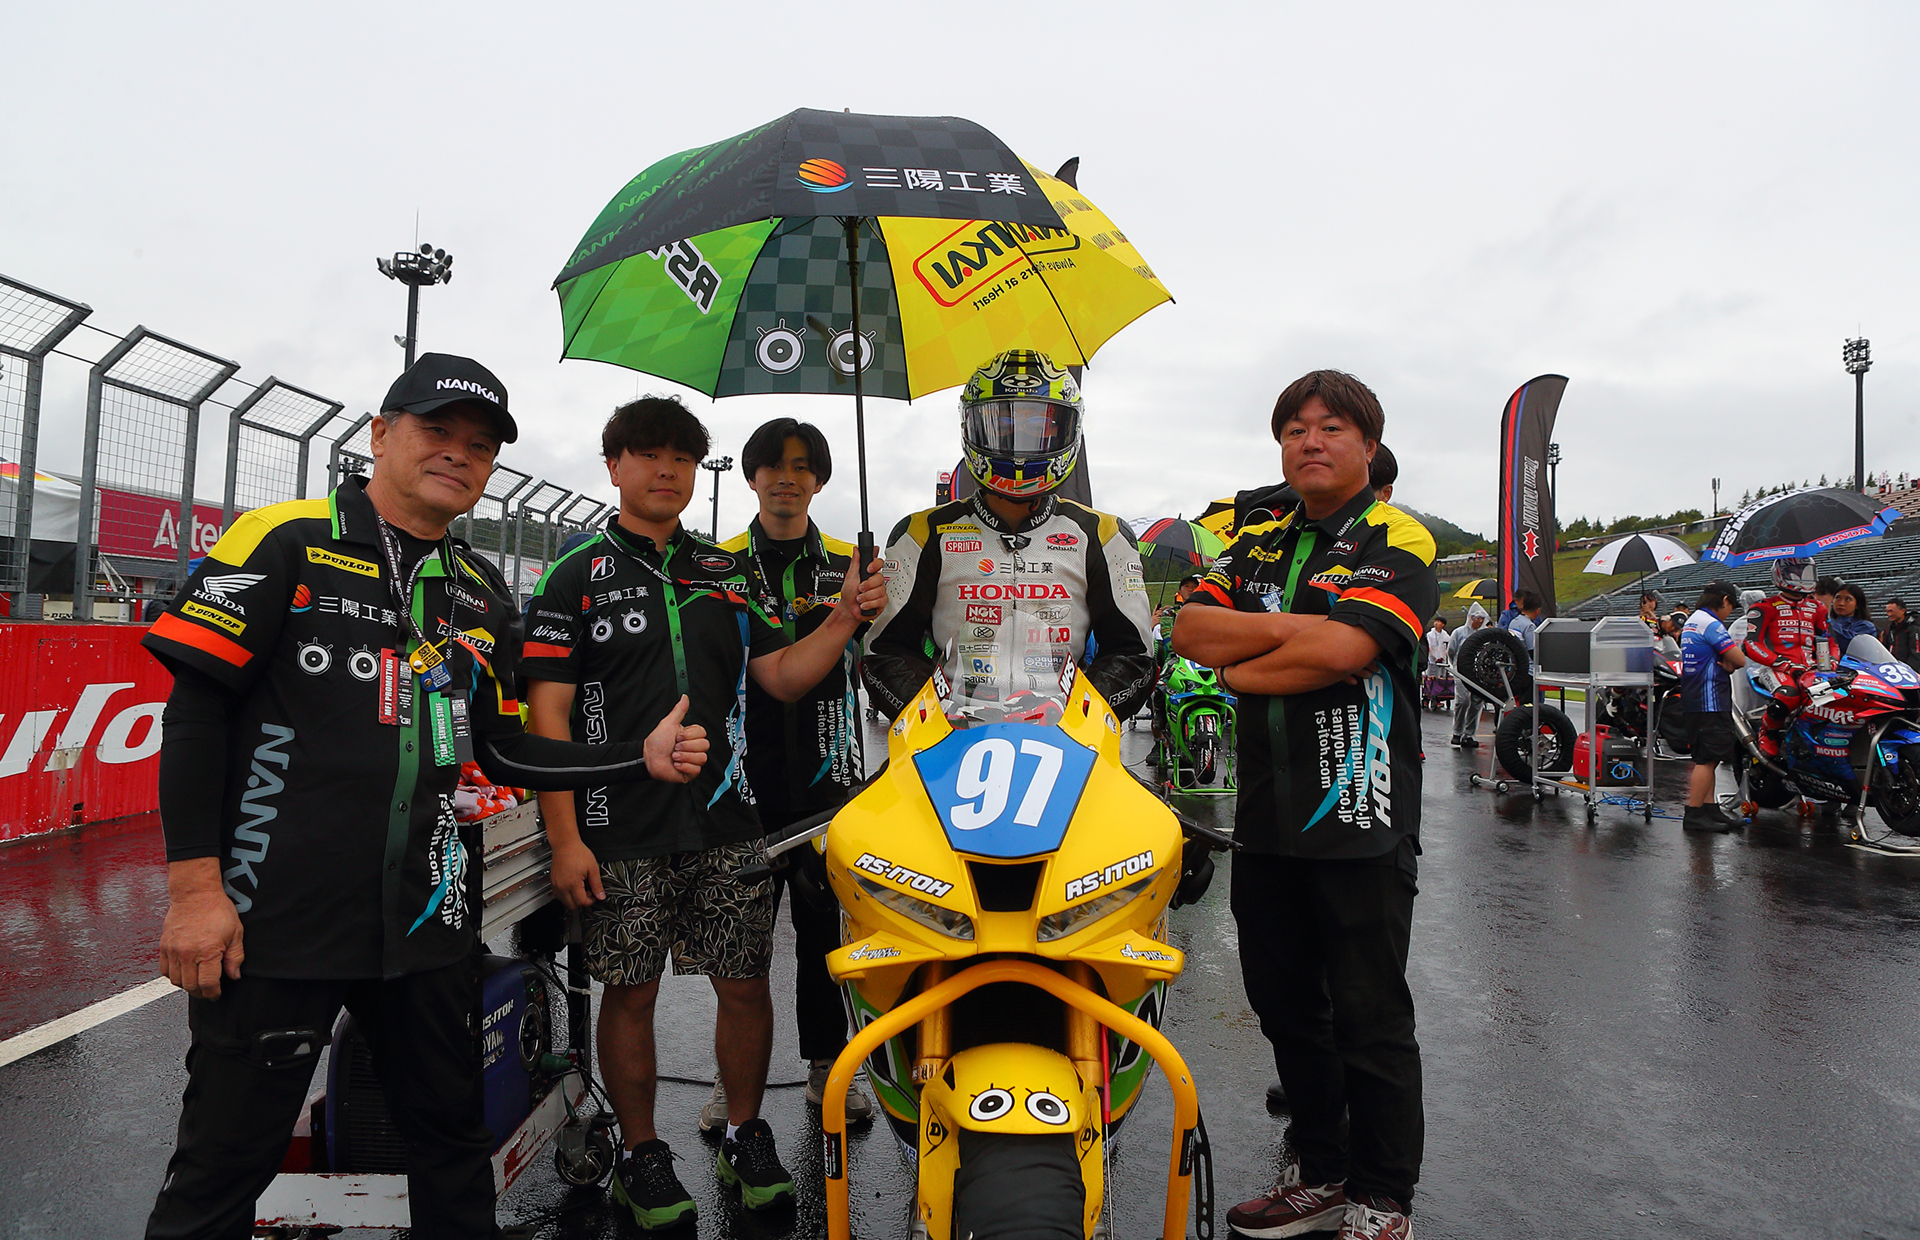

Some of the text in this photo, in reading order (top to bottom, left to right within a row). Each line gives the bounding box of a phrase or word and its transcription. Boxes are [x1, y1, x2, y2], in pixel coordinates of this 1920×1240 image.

[861, 167, 1028, 196] 三陽工業
[436, 378, 500, 405] NANKAI
[947, 541, 980, 552] SPRINTA
[1816, 527, 1873, 547] HONDA
[321, 553, 375, 573] DUNLOP
[191, 588, 246, 617] HONDA
[595, 586, 650, 606] 三陽工業
[958, 584, 1071, 600] HONDA
[194, 607, 241, 630] DUNLOP
[318, 595, 398, 628] 三陽工業
[968, 606, 998, 618] NGK
[532, 624, 571, 642] Ninja
[384, 658, 394, 716] MFJ PROMOTION
[1878, 664, 1918, 684] 35
[817, 700, 828, 759] rs-itoh.com
[1315, 710, 1332, 790] rs-itoh.com
[1364, 673, 1392, 829] S-ITOH
[1816, 746, 1848, 757] MOTUL
[1331, 707, 1354, 824] sanyou-ind.co.jp
[1347, 704, 1374, 830] nankaibuhin.co.jp
[949, 738, 1064, 830] 97
[222, 722, 296, 914] NANKA
[855, 852, 953, 898] RS-ITOH
[1066, 851, 1155, 900] RS-ITOH
